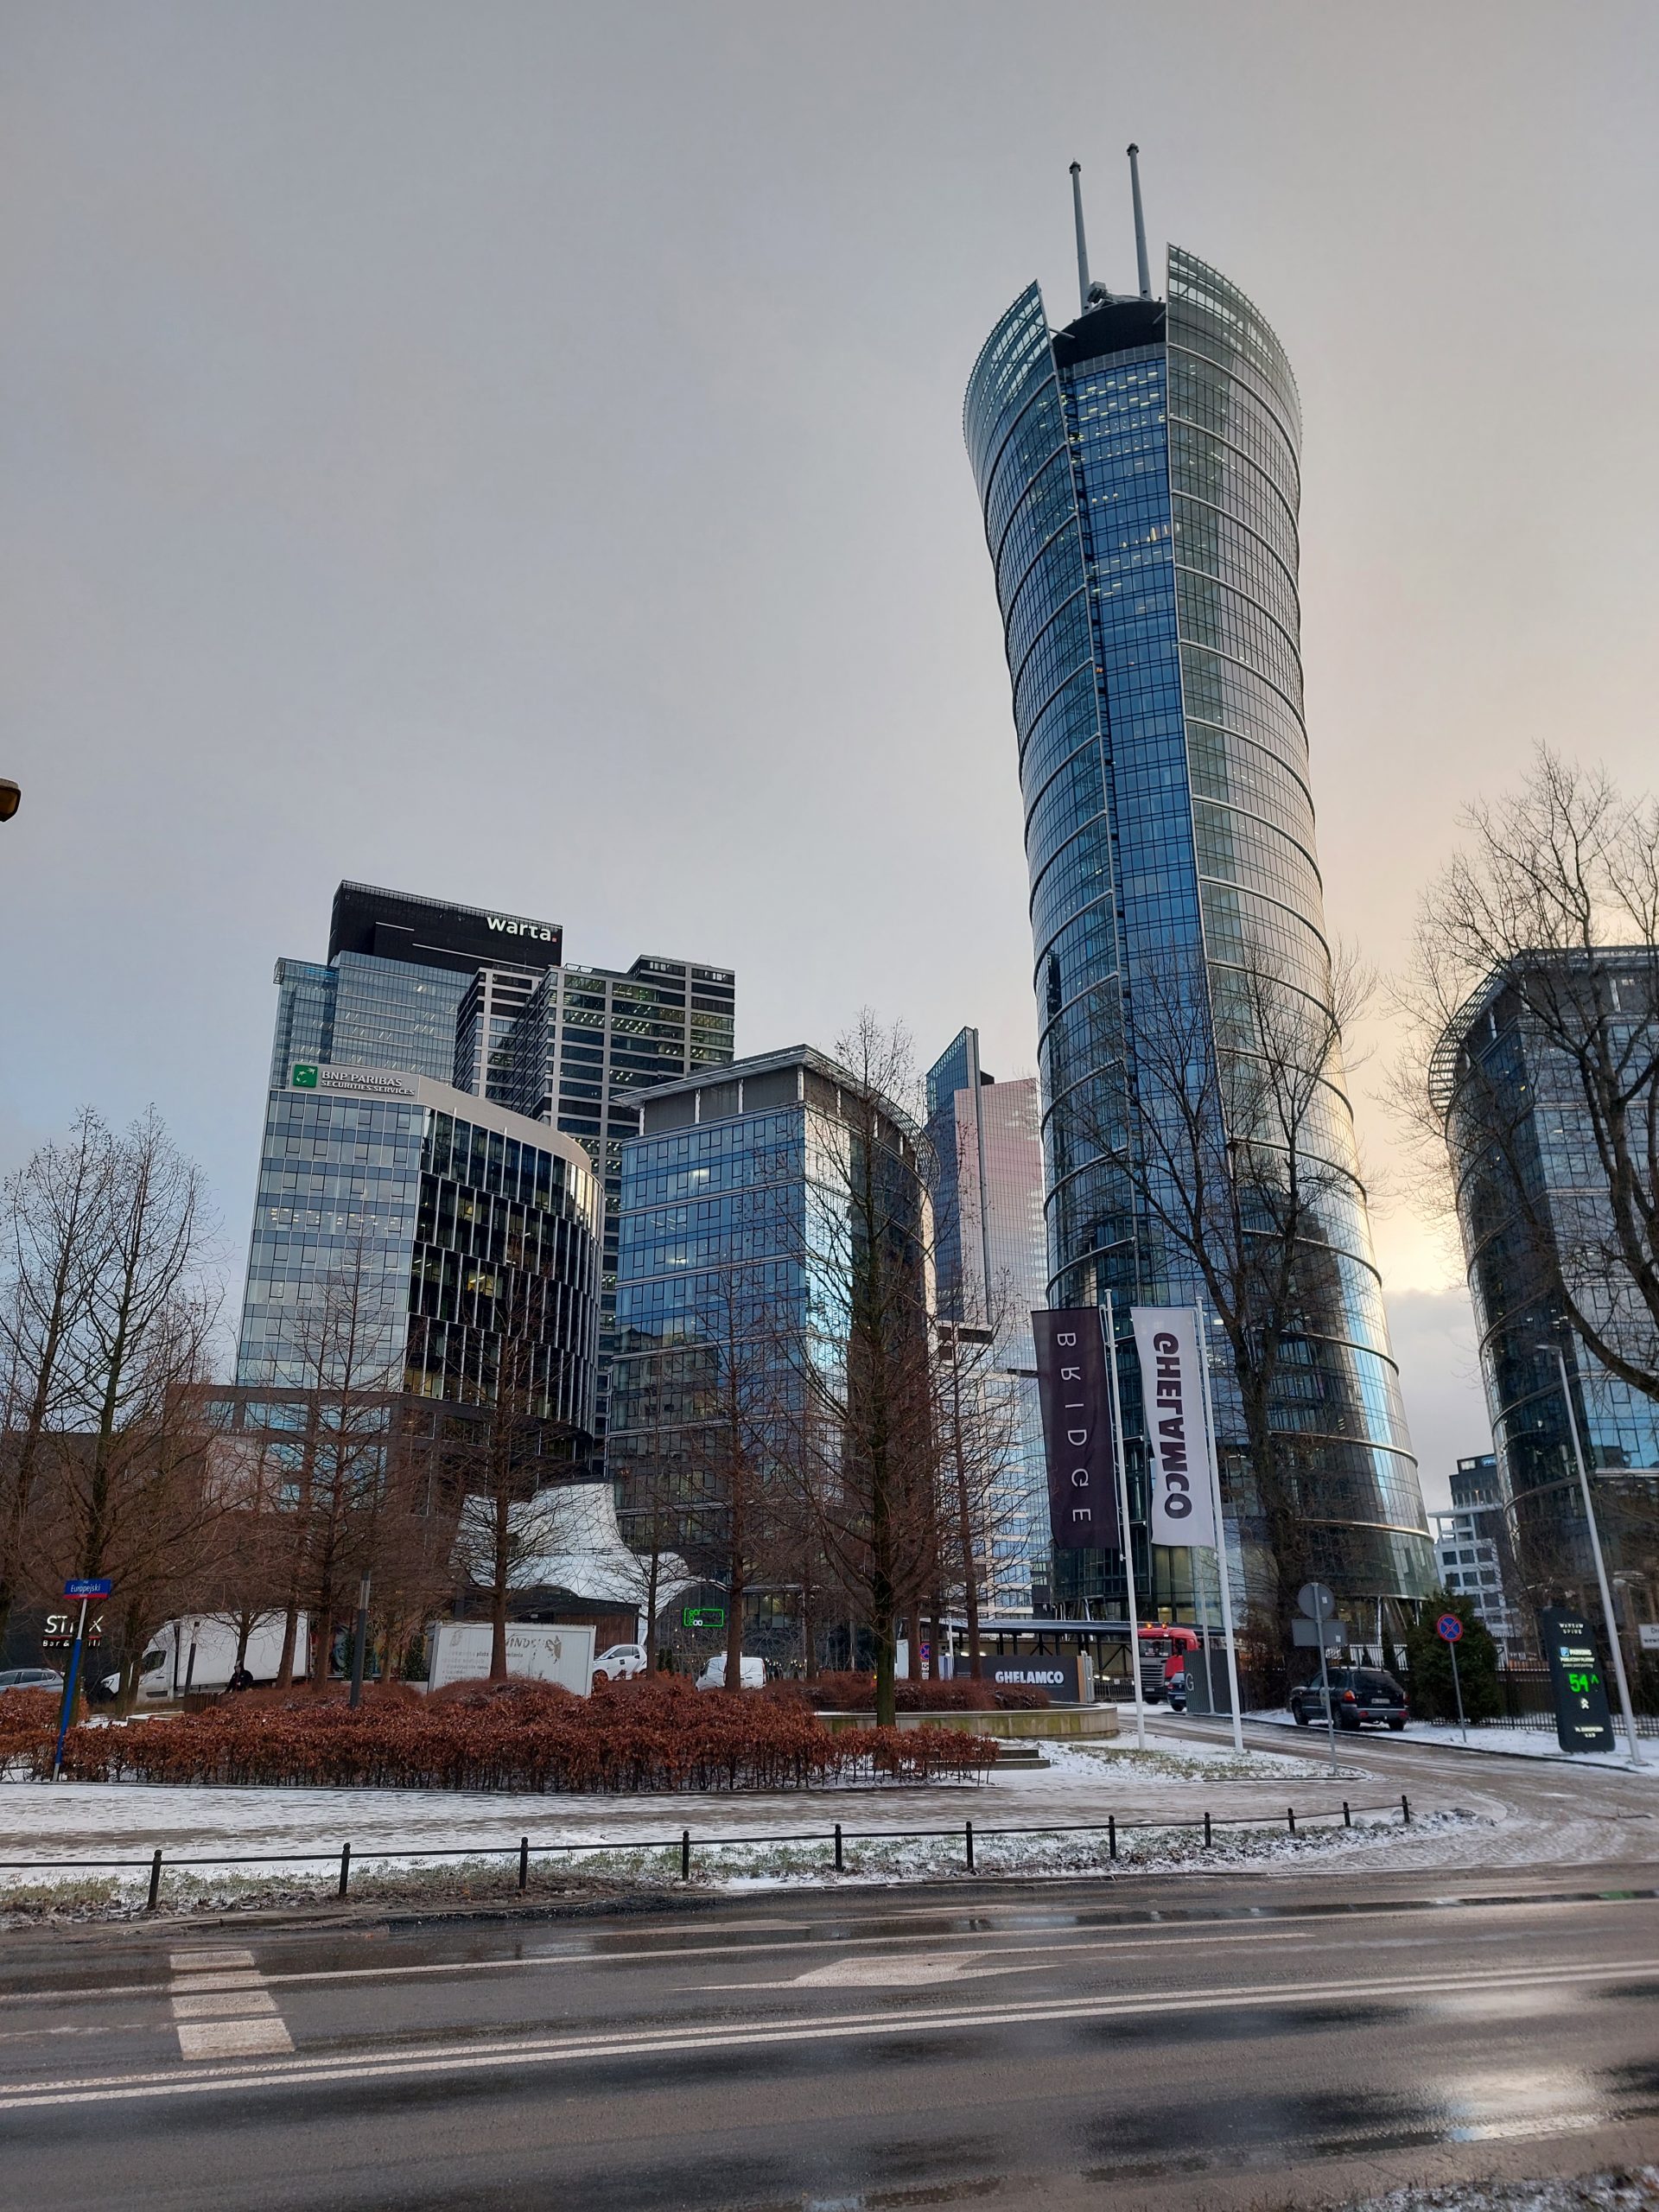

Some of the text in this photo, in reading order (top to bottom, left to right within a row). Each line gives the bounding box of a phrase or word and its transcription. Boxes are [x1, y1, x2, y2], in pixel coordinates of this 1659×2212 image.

[321, 1071, 402, 1087] BNP PARIBAS
[321, 1080, 415, 1096] SECURITIES SERVICES
[70, 1584, 101, 1594] Europejski
[995, 1670, 1065, 1684] GHELAMCO
